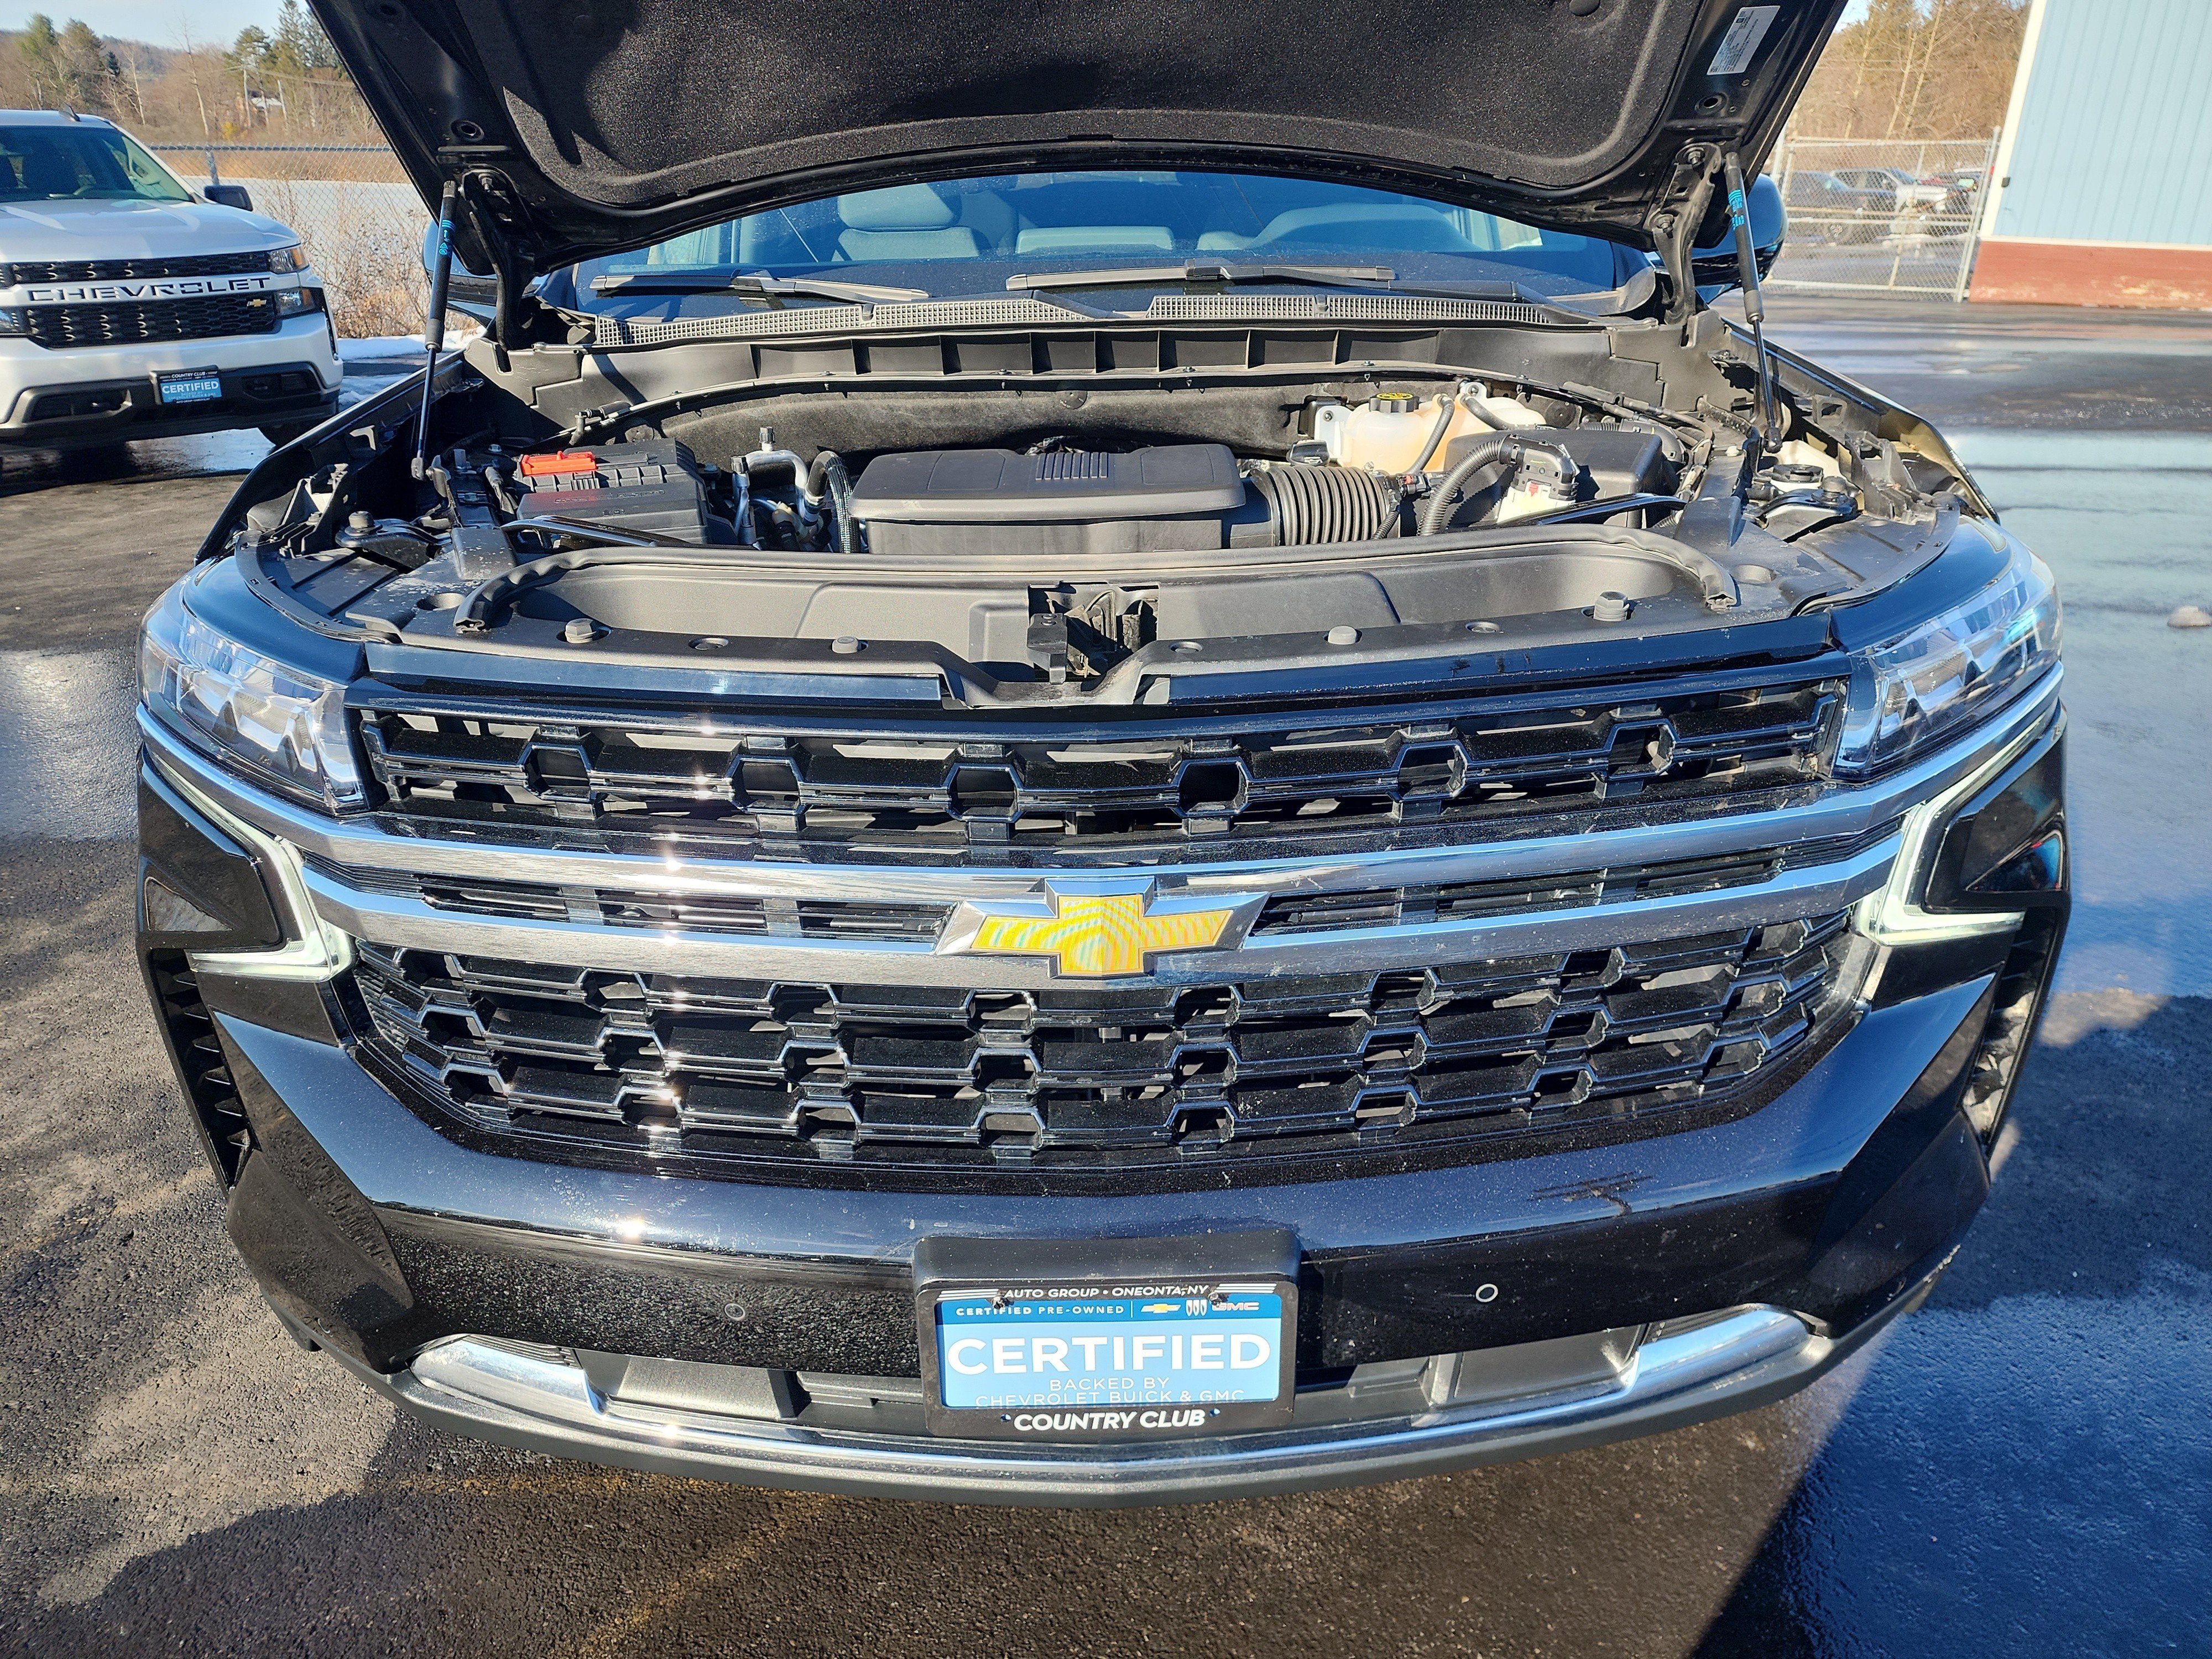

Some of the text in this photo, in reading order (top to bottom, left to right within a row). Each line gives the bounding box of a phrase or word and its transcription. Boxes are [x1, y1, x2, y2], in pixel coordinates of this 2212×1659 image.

[28, 277, 271, 302] CHEVROLET
[161, 381, 219, 394] CERTIFIED
[1004, 1288, 1044, 1298] AUTO
[1048, 1287, 1099, 1298] GROUP
[956, 1305, 1124, 1316] CERTIFIED PRE-OWNED
[1212, 1302, 1260, 1311] GMC
[947, 1333, 1271, 1375] CERTIFIED
[1050, 1376, 1170, 1391] BACKED BY
[975, 1389, 1245, 1407] CHEVROLET BUICK & GMC
[1014, 1409, 1206, 1431] COUNTRY CLUB
